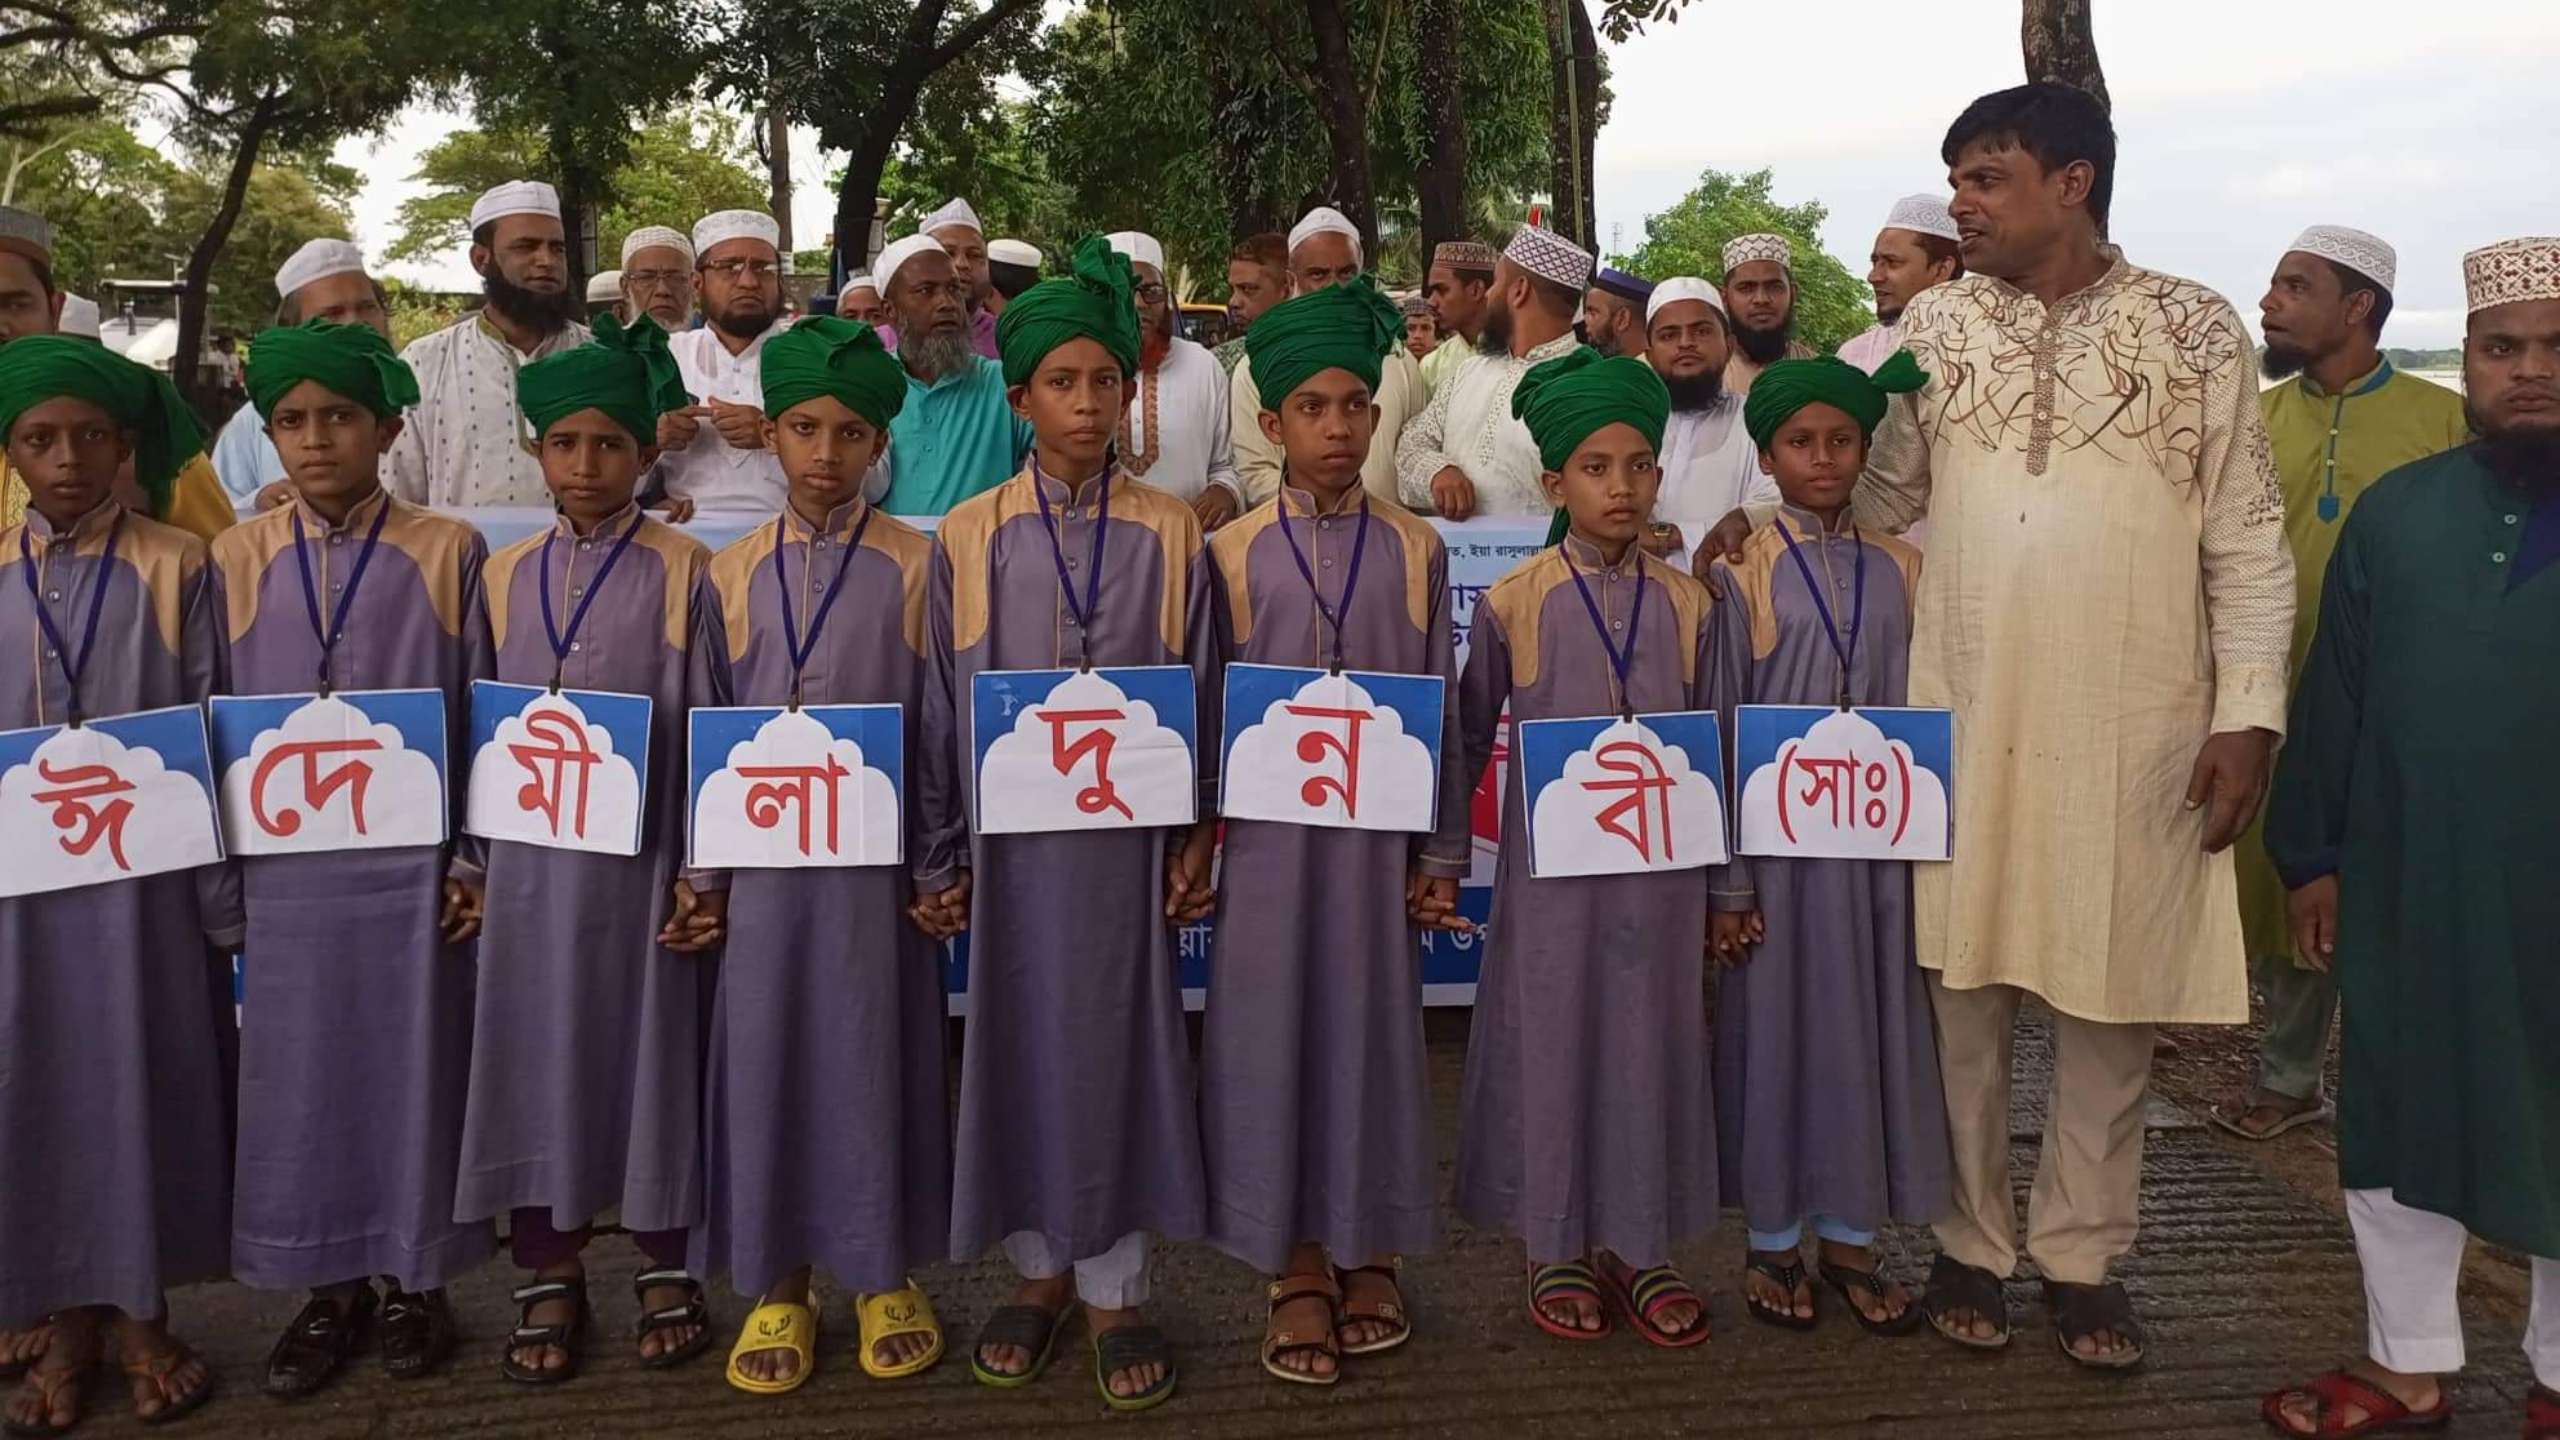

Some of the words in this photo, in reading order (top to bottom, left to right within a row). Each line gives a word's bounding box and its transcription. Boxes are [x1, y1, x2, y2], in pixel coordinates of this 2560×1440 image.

[32, 757, 135, 871] ঈ
[250, 738, 382, 838] দে
[507, 708, 603, 839] মী
[735, 752, 849, 857] লা
[1036, 707, 1135, 822] দু
[1284, 704, 1375, 820] ন্ন
[1581, 740, 1677, 865] বী
[1777, 742, 1912, 848] (সাঃ)
